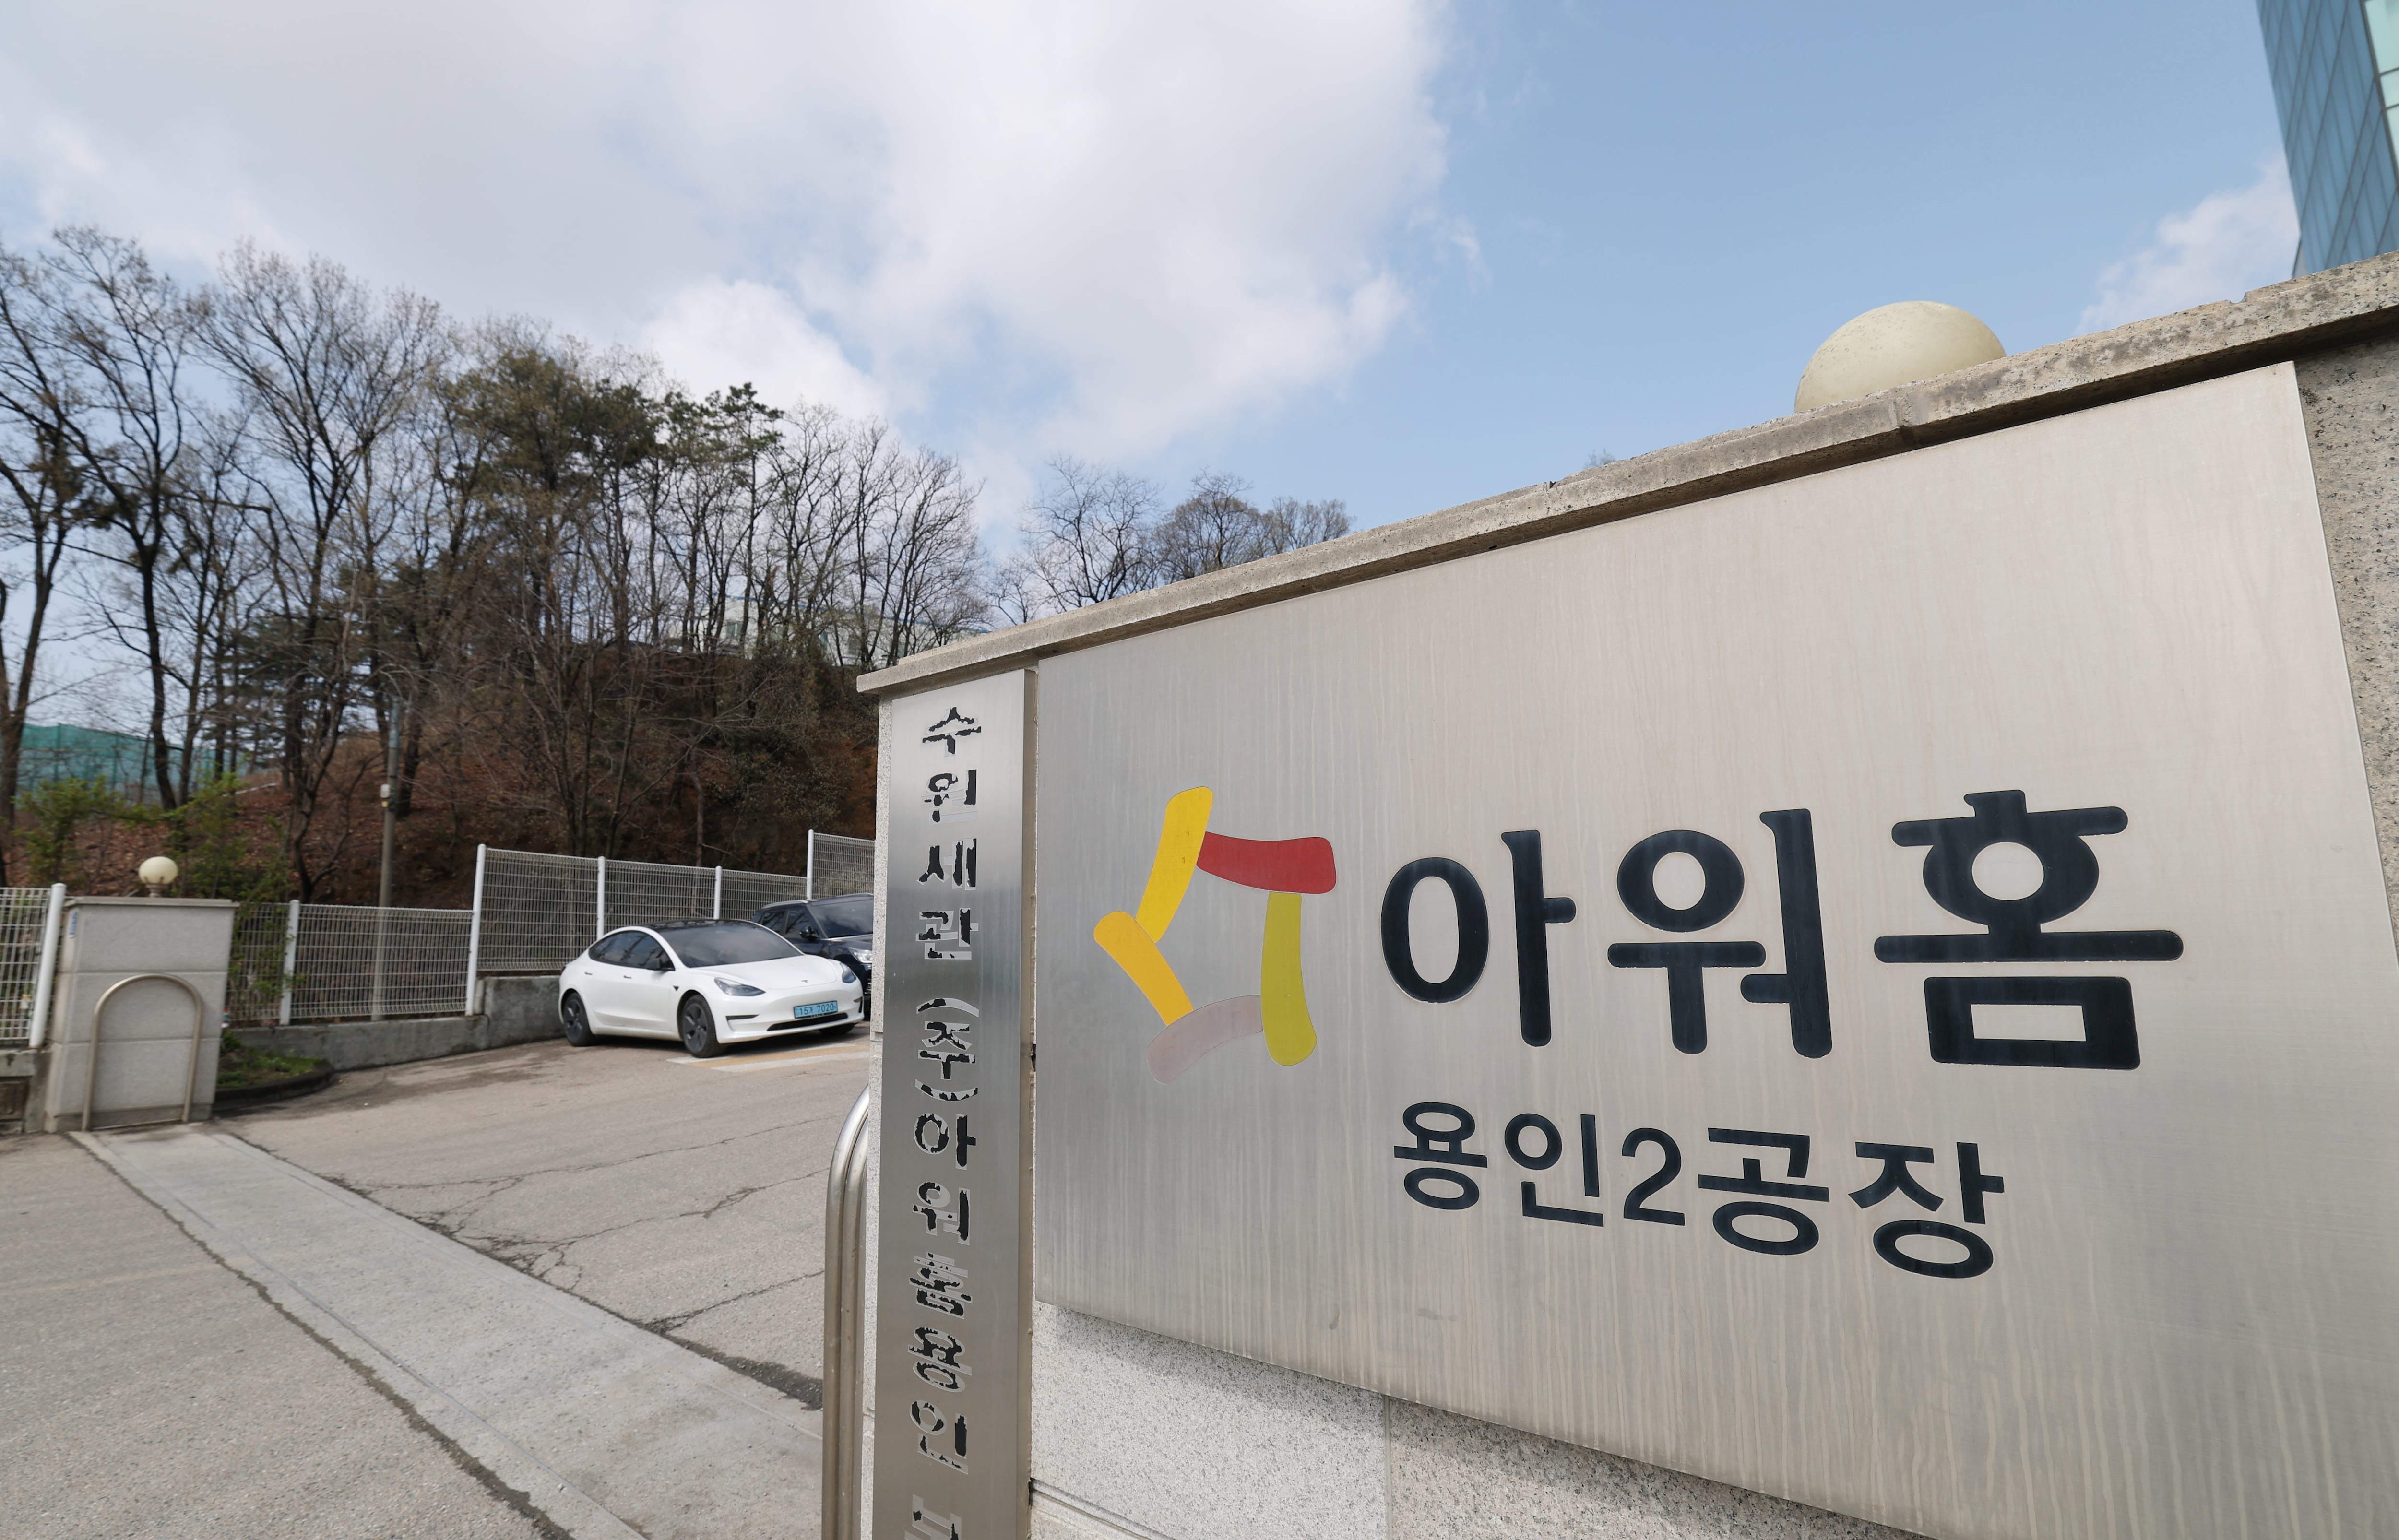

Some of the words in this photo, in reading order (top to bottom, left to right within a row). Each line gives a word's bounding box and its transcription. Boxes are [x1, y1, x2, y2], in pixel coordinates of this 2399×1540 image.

[817, 1003, 834, 1013] 7020
[1381, 790, 2183, 1070] 아워홈
[1394, 1102, 2004, 1278] 용인2공장
